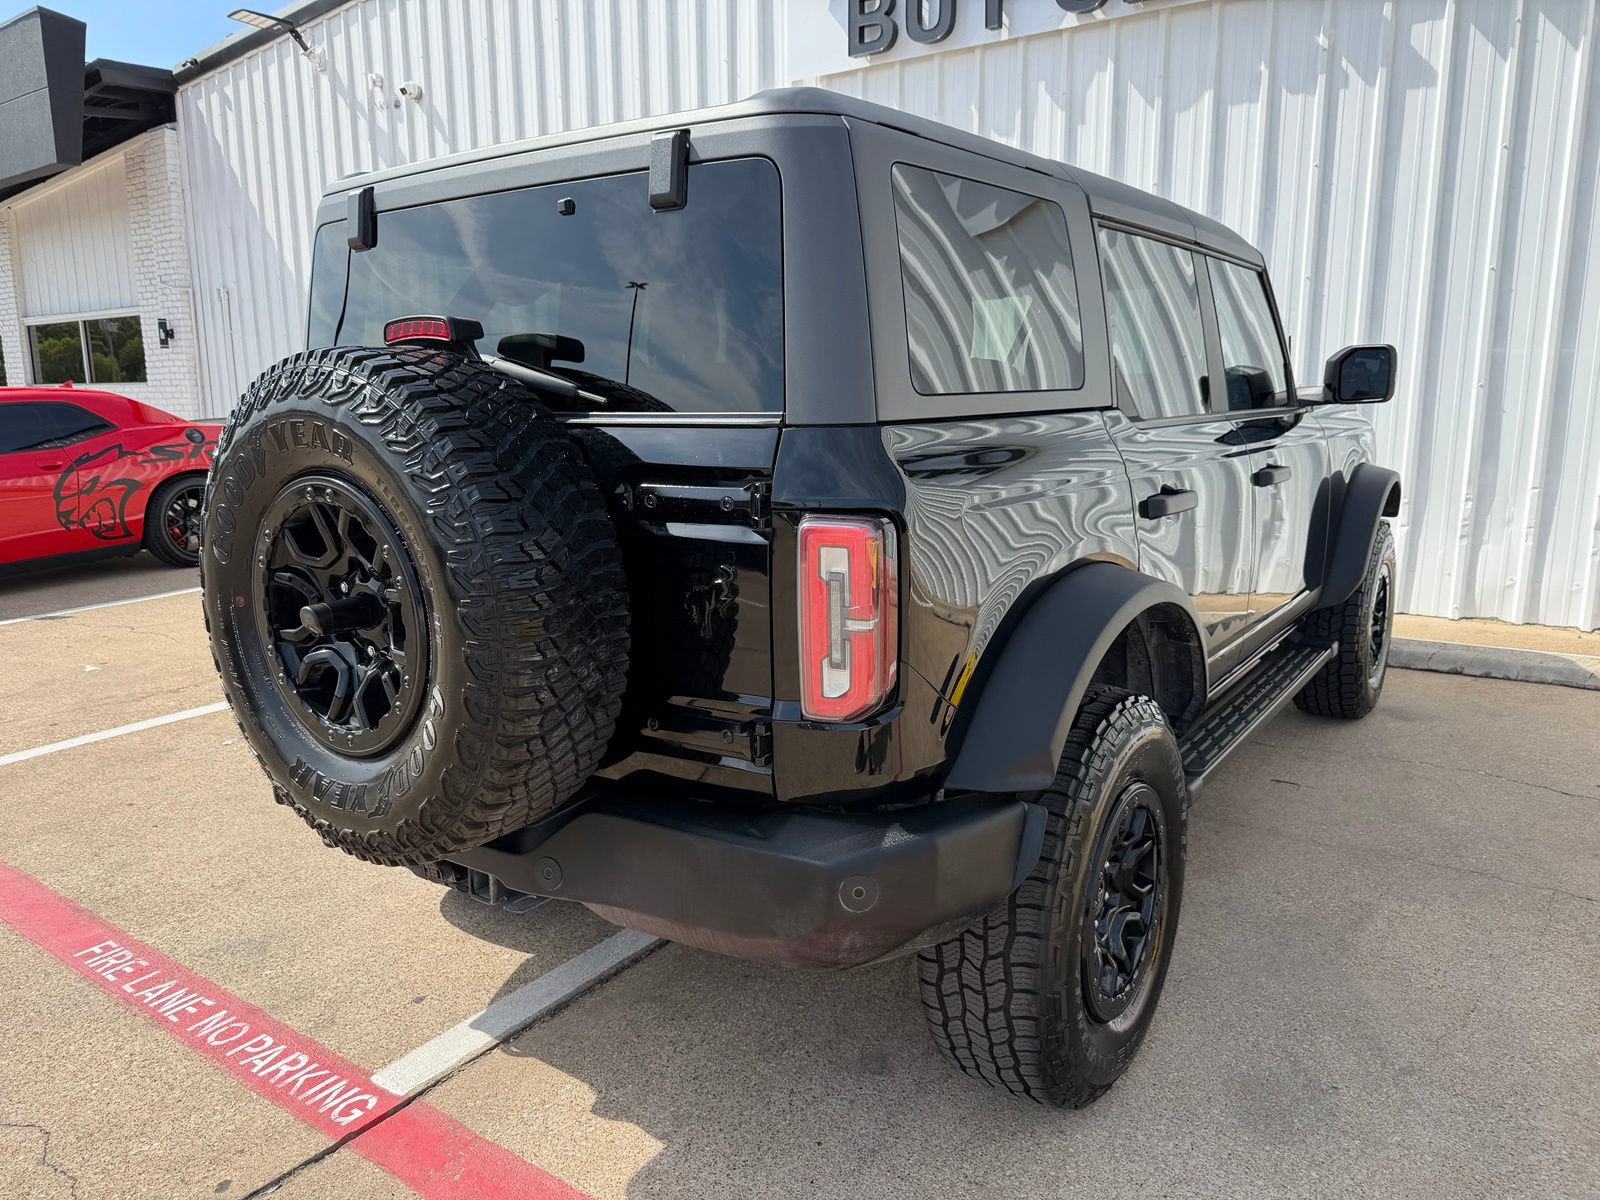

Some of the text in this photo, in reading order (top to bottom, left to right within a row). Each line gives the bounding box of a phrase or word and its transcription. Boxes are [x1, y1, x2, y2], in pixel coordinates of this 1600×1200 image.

[73, 939, 378, 1126] FIRE LANE NO PARKING
